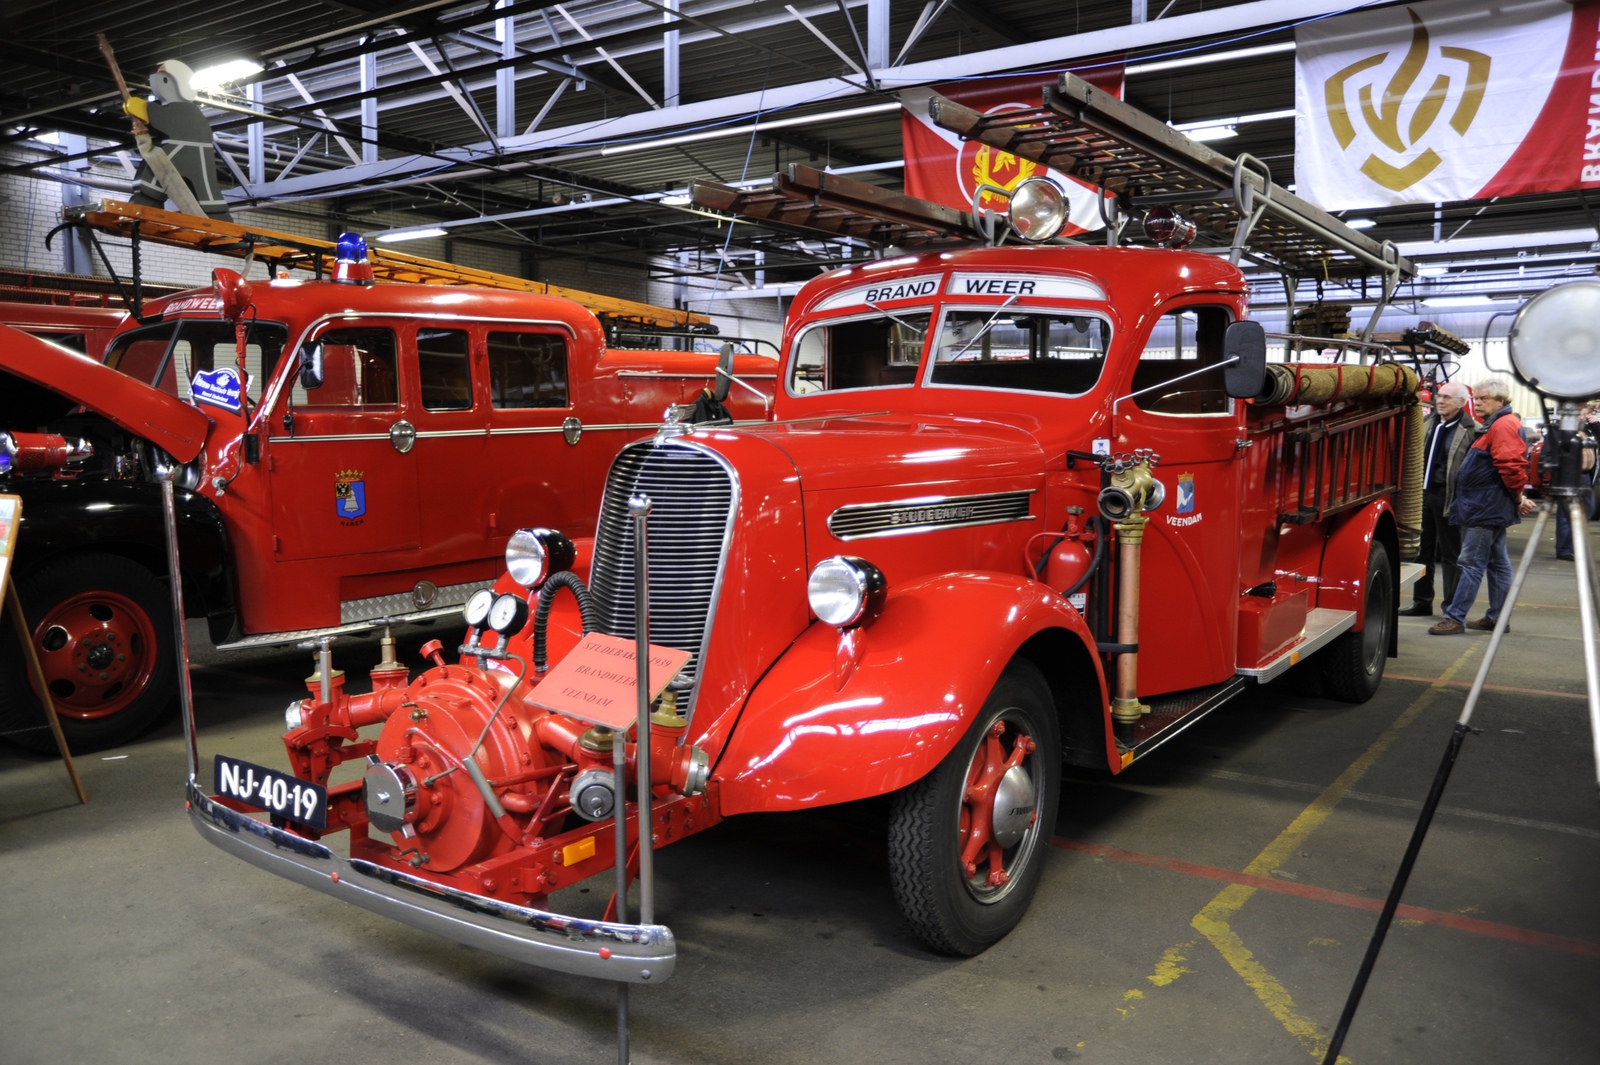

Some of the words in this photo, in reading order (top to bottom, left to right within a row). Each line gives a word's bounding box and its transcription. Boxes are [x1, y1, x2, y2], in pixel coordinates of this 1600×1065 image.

[865, 281, 935, 302] BRAND
[966, 279, 1036, 295] WEER
[163, 297, 220, 314] BRANDWEE
[890, 506, 974, 524] STUDEBAKER
[1166, 513, 1203, 527] VEENDAM
[582, 642, 638, 661] STUDEBAK
[649, 657, 673, 668] 1939
[561, 687, 614, 708] VEENDAM
[221, 762, 318, 820] NJ-40-19
